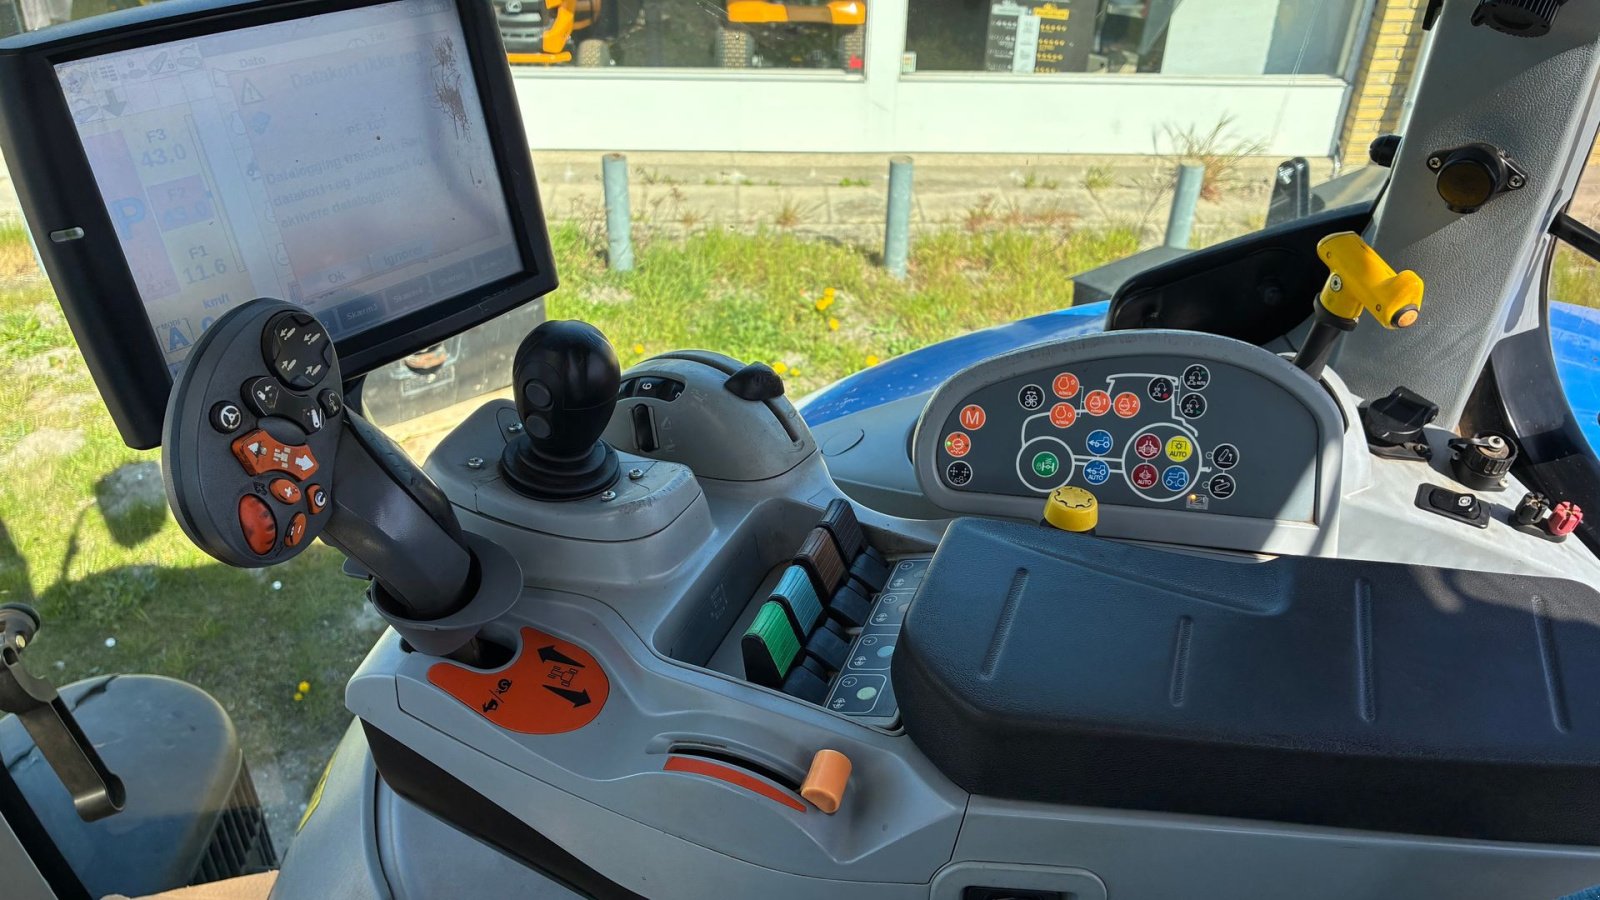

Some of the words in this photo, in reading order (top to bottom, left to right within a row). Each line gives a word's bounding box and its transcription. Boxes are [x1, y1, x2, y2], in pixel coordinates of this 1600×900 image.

[239, 55, 266, 68] Dato
[290, 62, 362, 89] Datakort
[147, 128, 167, 143] F3
[141, 144, 187, 168] 43.0
[111, 197, 146, 240] P
[188, 245, 209, 260] F1
[183, 258, 227, 284] 11.6
[169, 326, 191, 352] A
[965, 411, 979, 425] M
[1169, 450, 1187, 458] AUTO
[1088, 474, 1104, 482] AUTO
